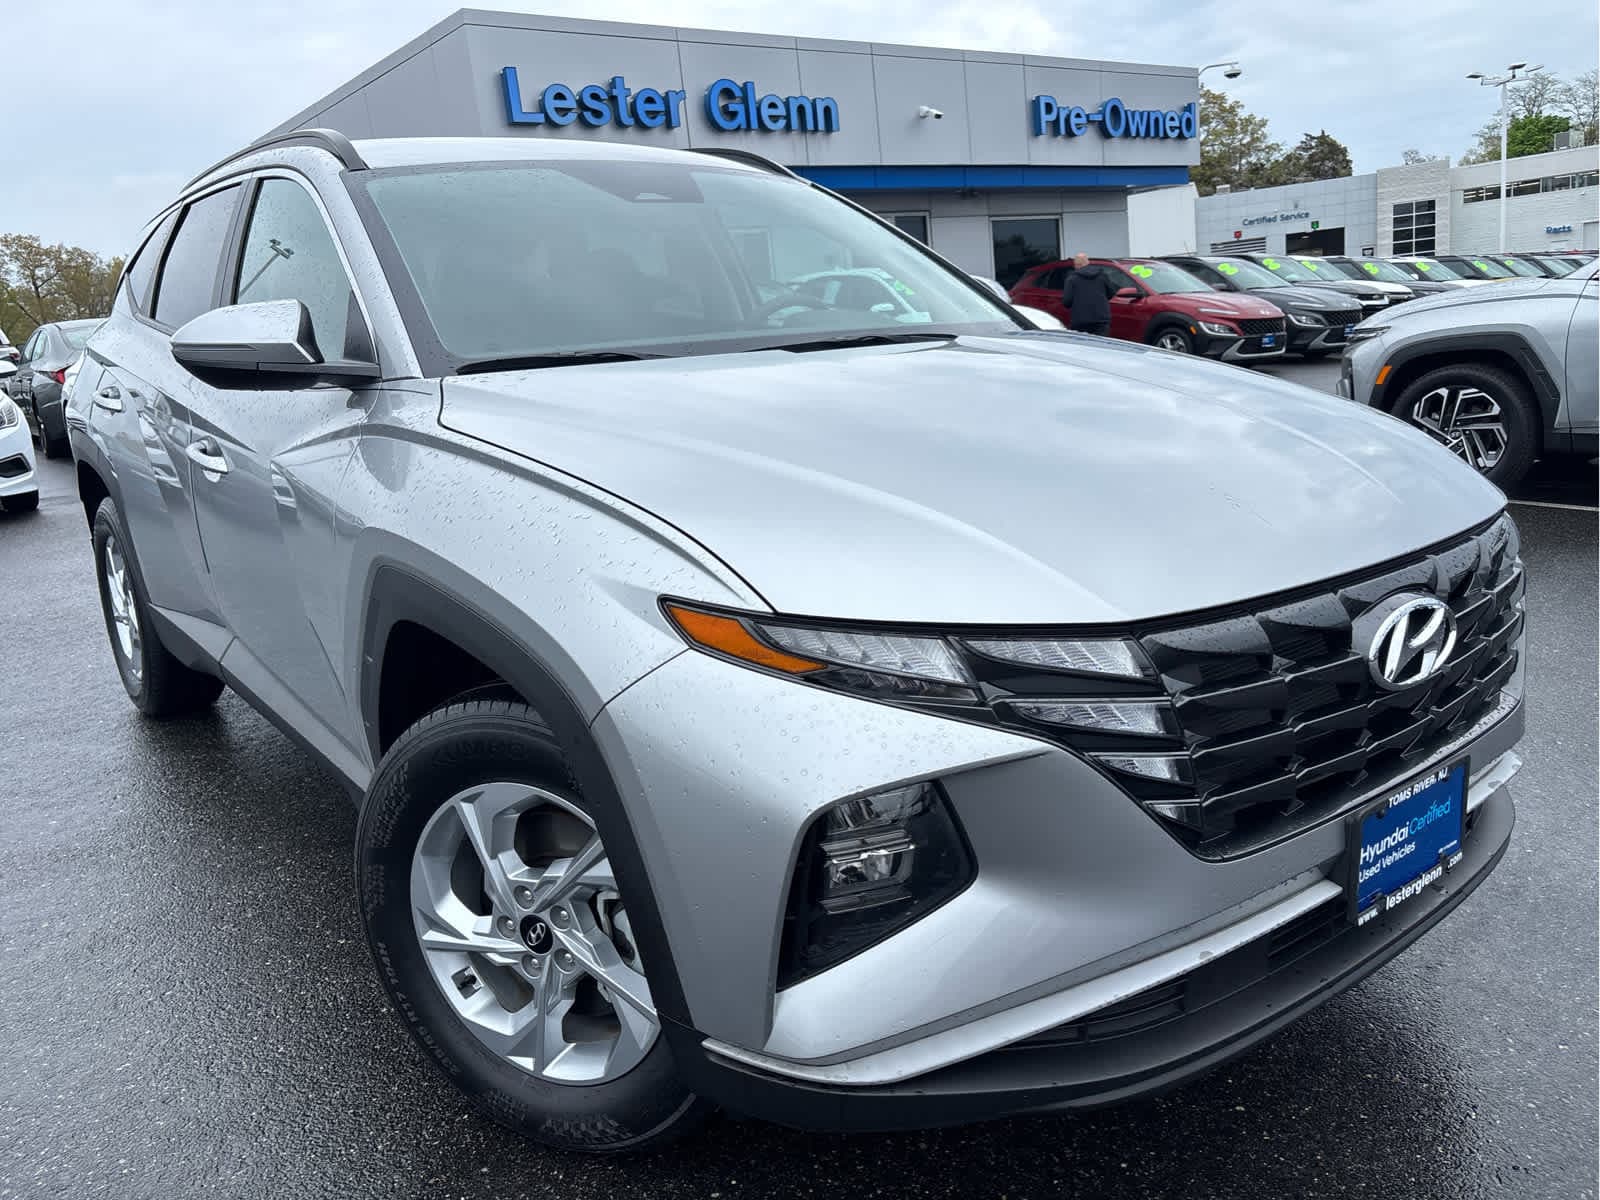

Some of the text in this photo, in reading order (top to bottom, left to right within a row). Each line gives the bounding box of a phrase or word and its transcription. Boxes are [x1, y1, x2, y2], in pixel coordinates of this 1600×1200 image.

[500, 66, 841, 132] Lester Glenn
[1033, 94, 1197, 138] Pre-Owned
[1242, 211, 1310, 226] Certified Service
[1545, 225, 1572, 234] Parts
[1388, 787, 1412, 808] TOMS
[1437, 767, 1448, 782] NJ
[1359, 841, 1416, 883] Used Vehicles
[1386, 866, 1443, 911] lesterglenn
